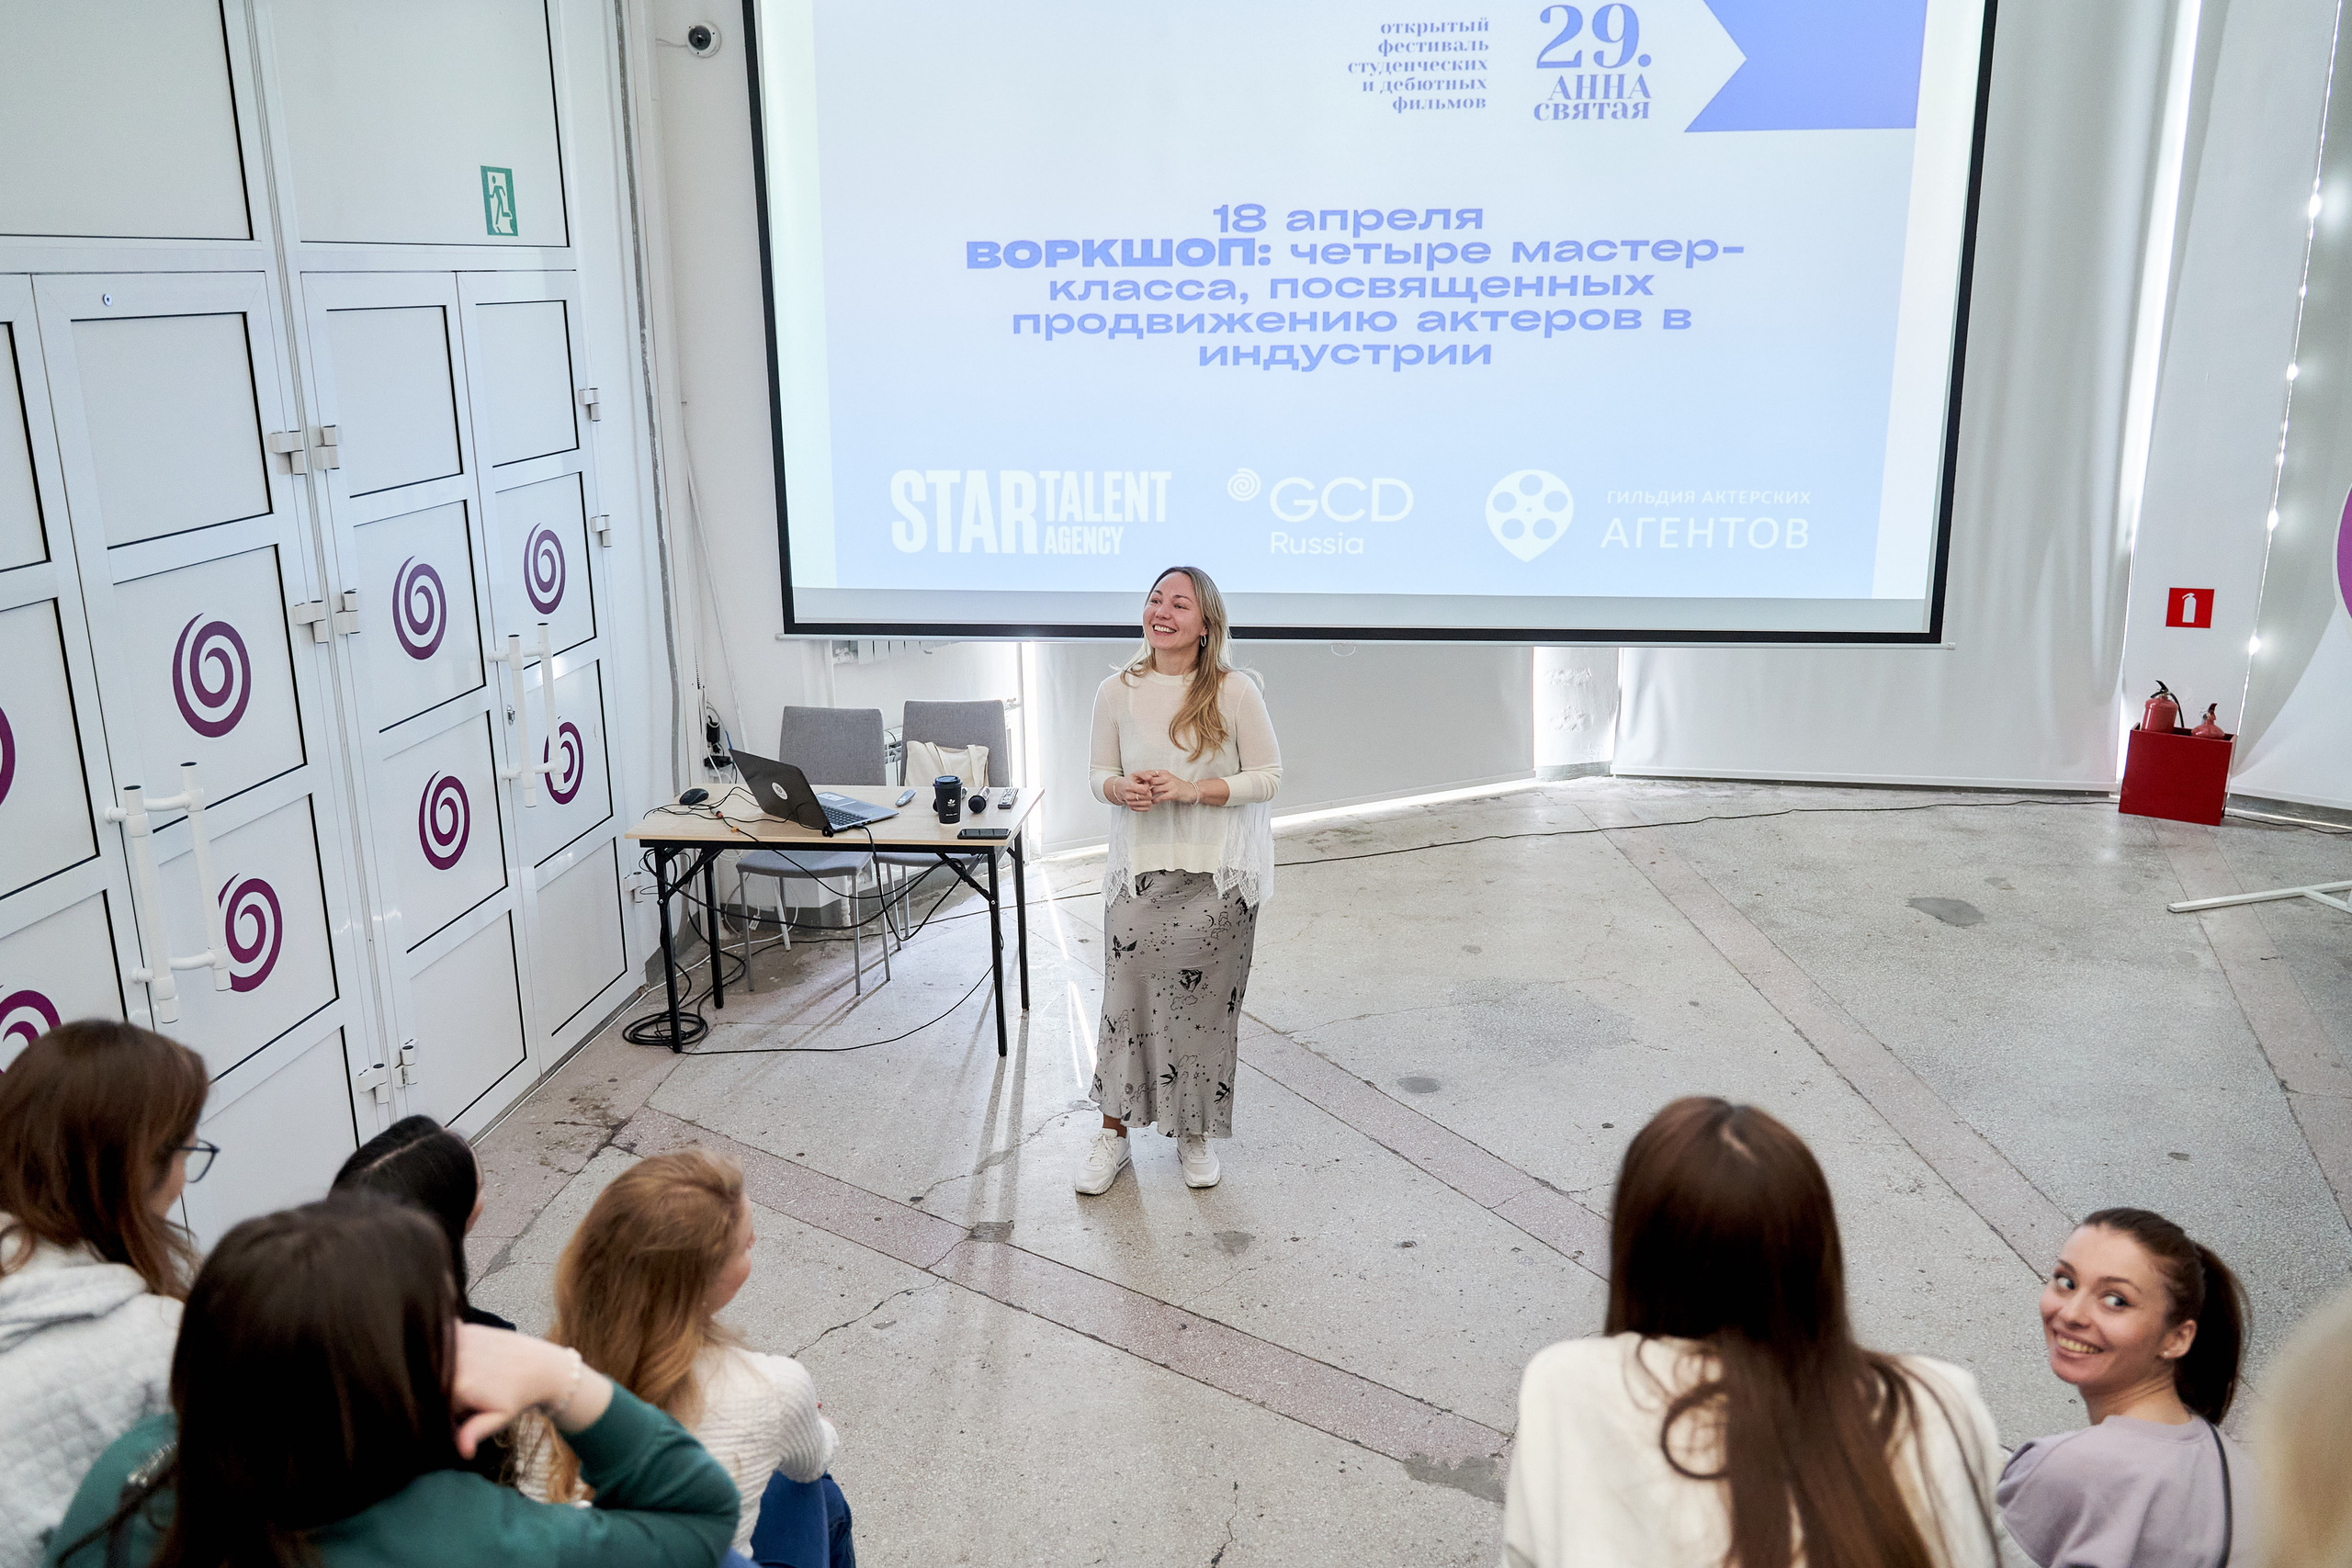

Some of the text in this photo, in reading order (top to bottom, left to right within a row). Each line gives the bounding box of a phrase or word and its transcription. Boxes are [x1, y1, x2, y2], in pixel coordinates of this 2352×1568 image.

[1380, 17, 1488, 37] открытый
[1537, 4, 1651, 69] 29.
[1377, 39, 1489, 57] фестиваль
[1347, 59, 1487, 75] студенческих
[1363, 76, 1487, 94] и дебютных
[1548, 73, 1652, 100] АННА
[1393, 96, 1486, 113] фильмов
[1533, 101, 1649, 120] святая
[1214, 204, 1483, 238] 18 апреля
[967, 238, 1744, 271] ВОРКШОП: четыре мастер-
[1050, 274, 1655, 304] класса, посвященных
[1013, 310, 1691, 341] продвижению актеров в
[1200, 344, 1491, 372] индустрии
[891, 469, 1171, 554] STAR TALENT
[1270, 478, 1413, 522] GCD
[1608, 490, 1811, 507] ГИЛЬДИЯ АКТЕРСКИХ
[1045, 526, 1124, 554] AGENCY
[1271, 532, 1363, 554] Russia
[1600, 517, 1808, 548] АГЕНТОВ
